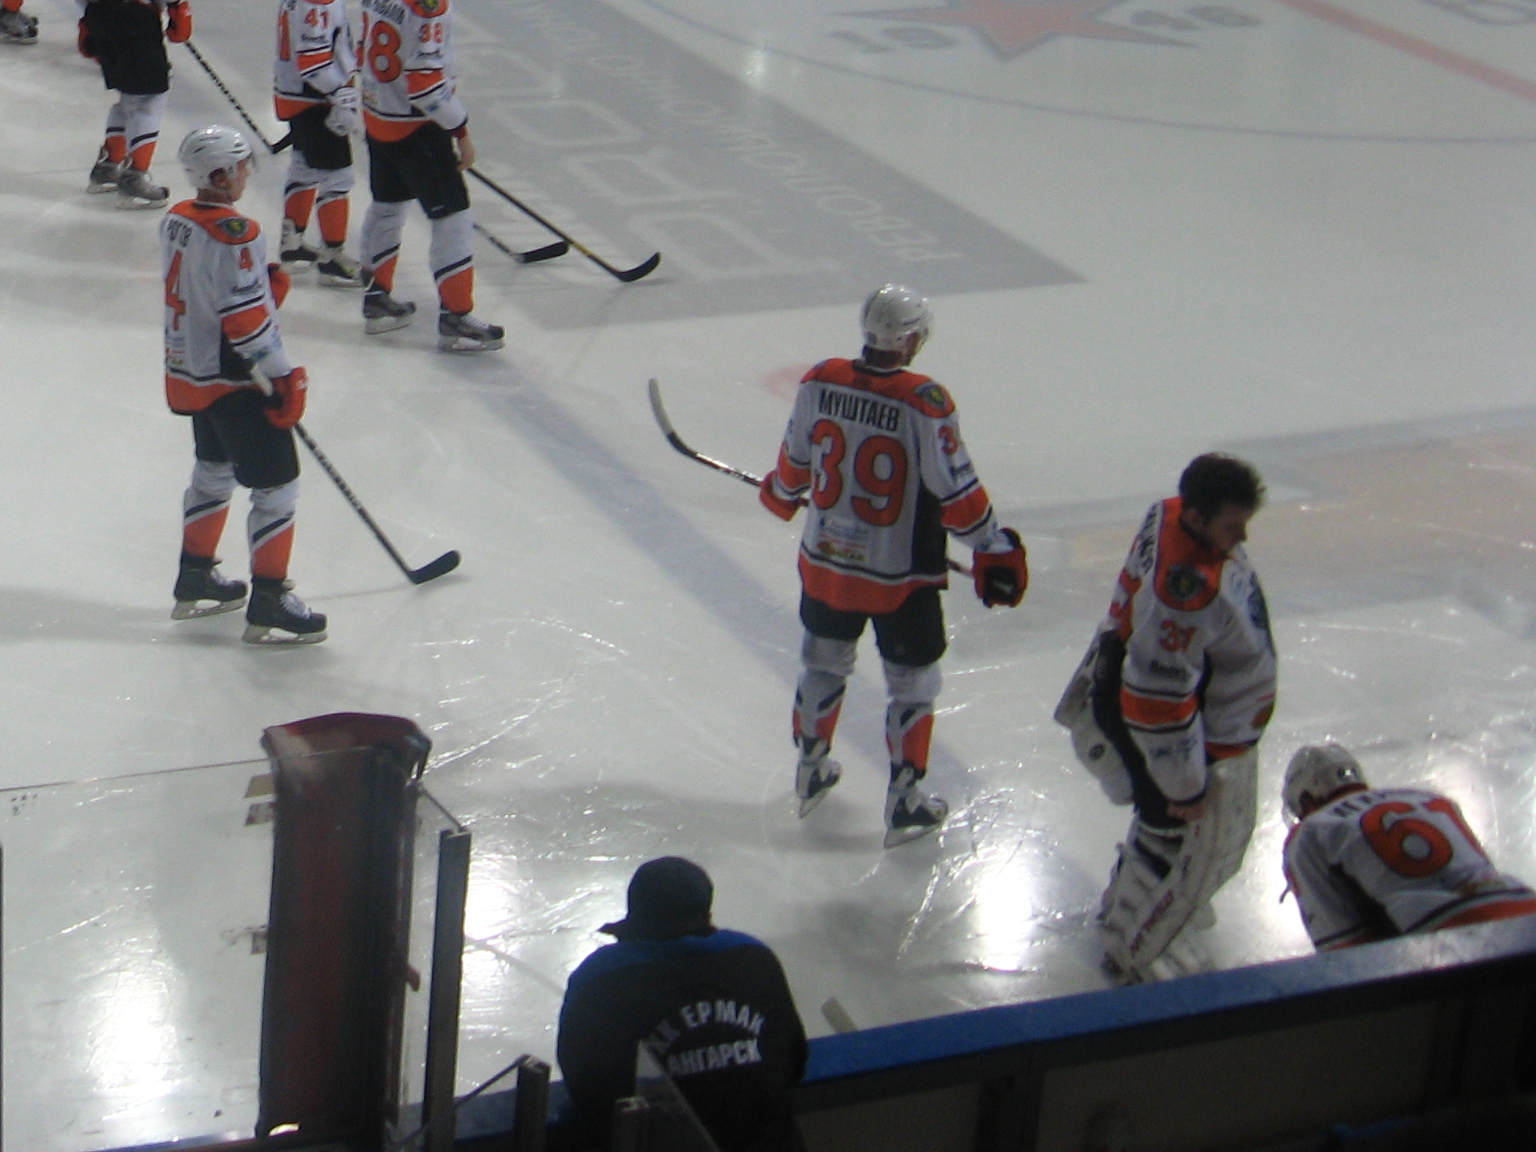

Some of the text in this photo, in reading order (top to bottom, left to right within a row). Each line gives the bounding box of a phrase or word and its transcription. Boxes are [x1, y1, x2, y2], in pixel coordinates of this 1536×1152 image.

[304, 8, 330, 29] 41
[818, 388, 900, 432] МУШТАЕВ
[810, 418, 908, 527] 39
[680, 998, 765, 1036] ЕРМАК
